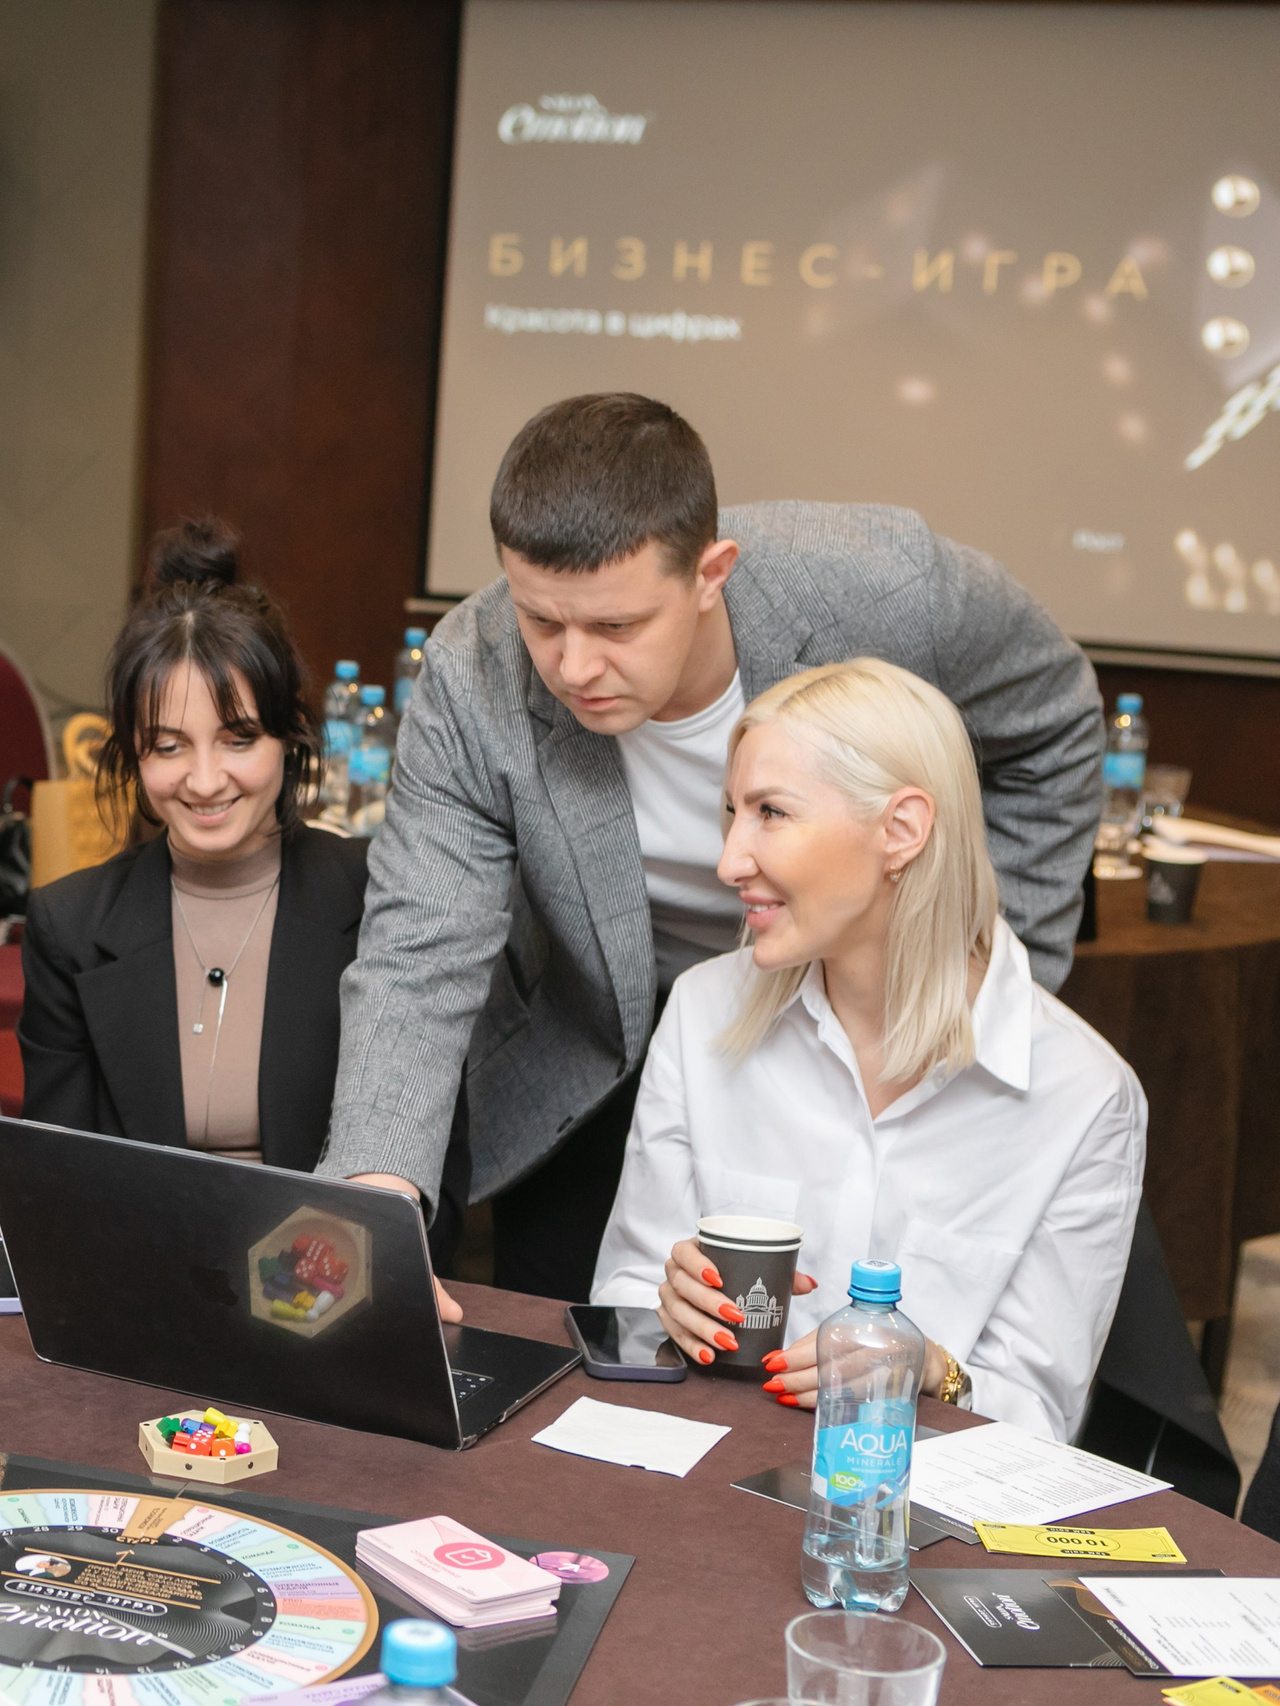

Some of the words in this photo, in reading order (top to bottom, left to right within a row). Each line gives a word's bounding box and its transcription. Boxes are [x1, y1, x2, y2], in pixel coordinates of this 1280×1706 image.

[488, 233, 1149, 300] БИЗНЕС-ИГРА
[484, 303, 593, 334] Красота
[604, 309, 626, 336] в
[628, 311, 742, 342] цифрах
[840, 1428, 907, 1458] AQUA
[847, 1456, 901, 1467] MINERALE
[835, 1474, 867, 1488] 100%
[116, 1536, 158, 1546] СТАРТ
[1046, 1537, 1082, 1545] 000
[15, 1582, 155, 1613] БИЗНЕС-ИГРА
[252, 1629, 263, 1637] 9
